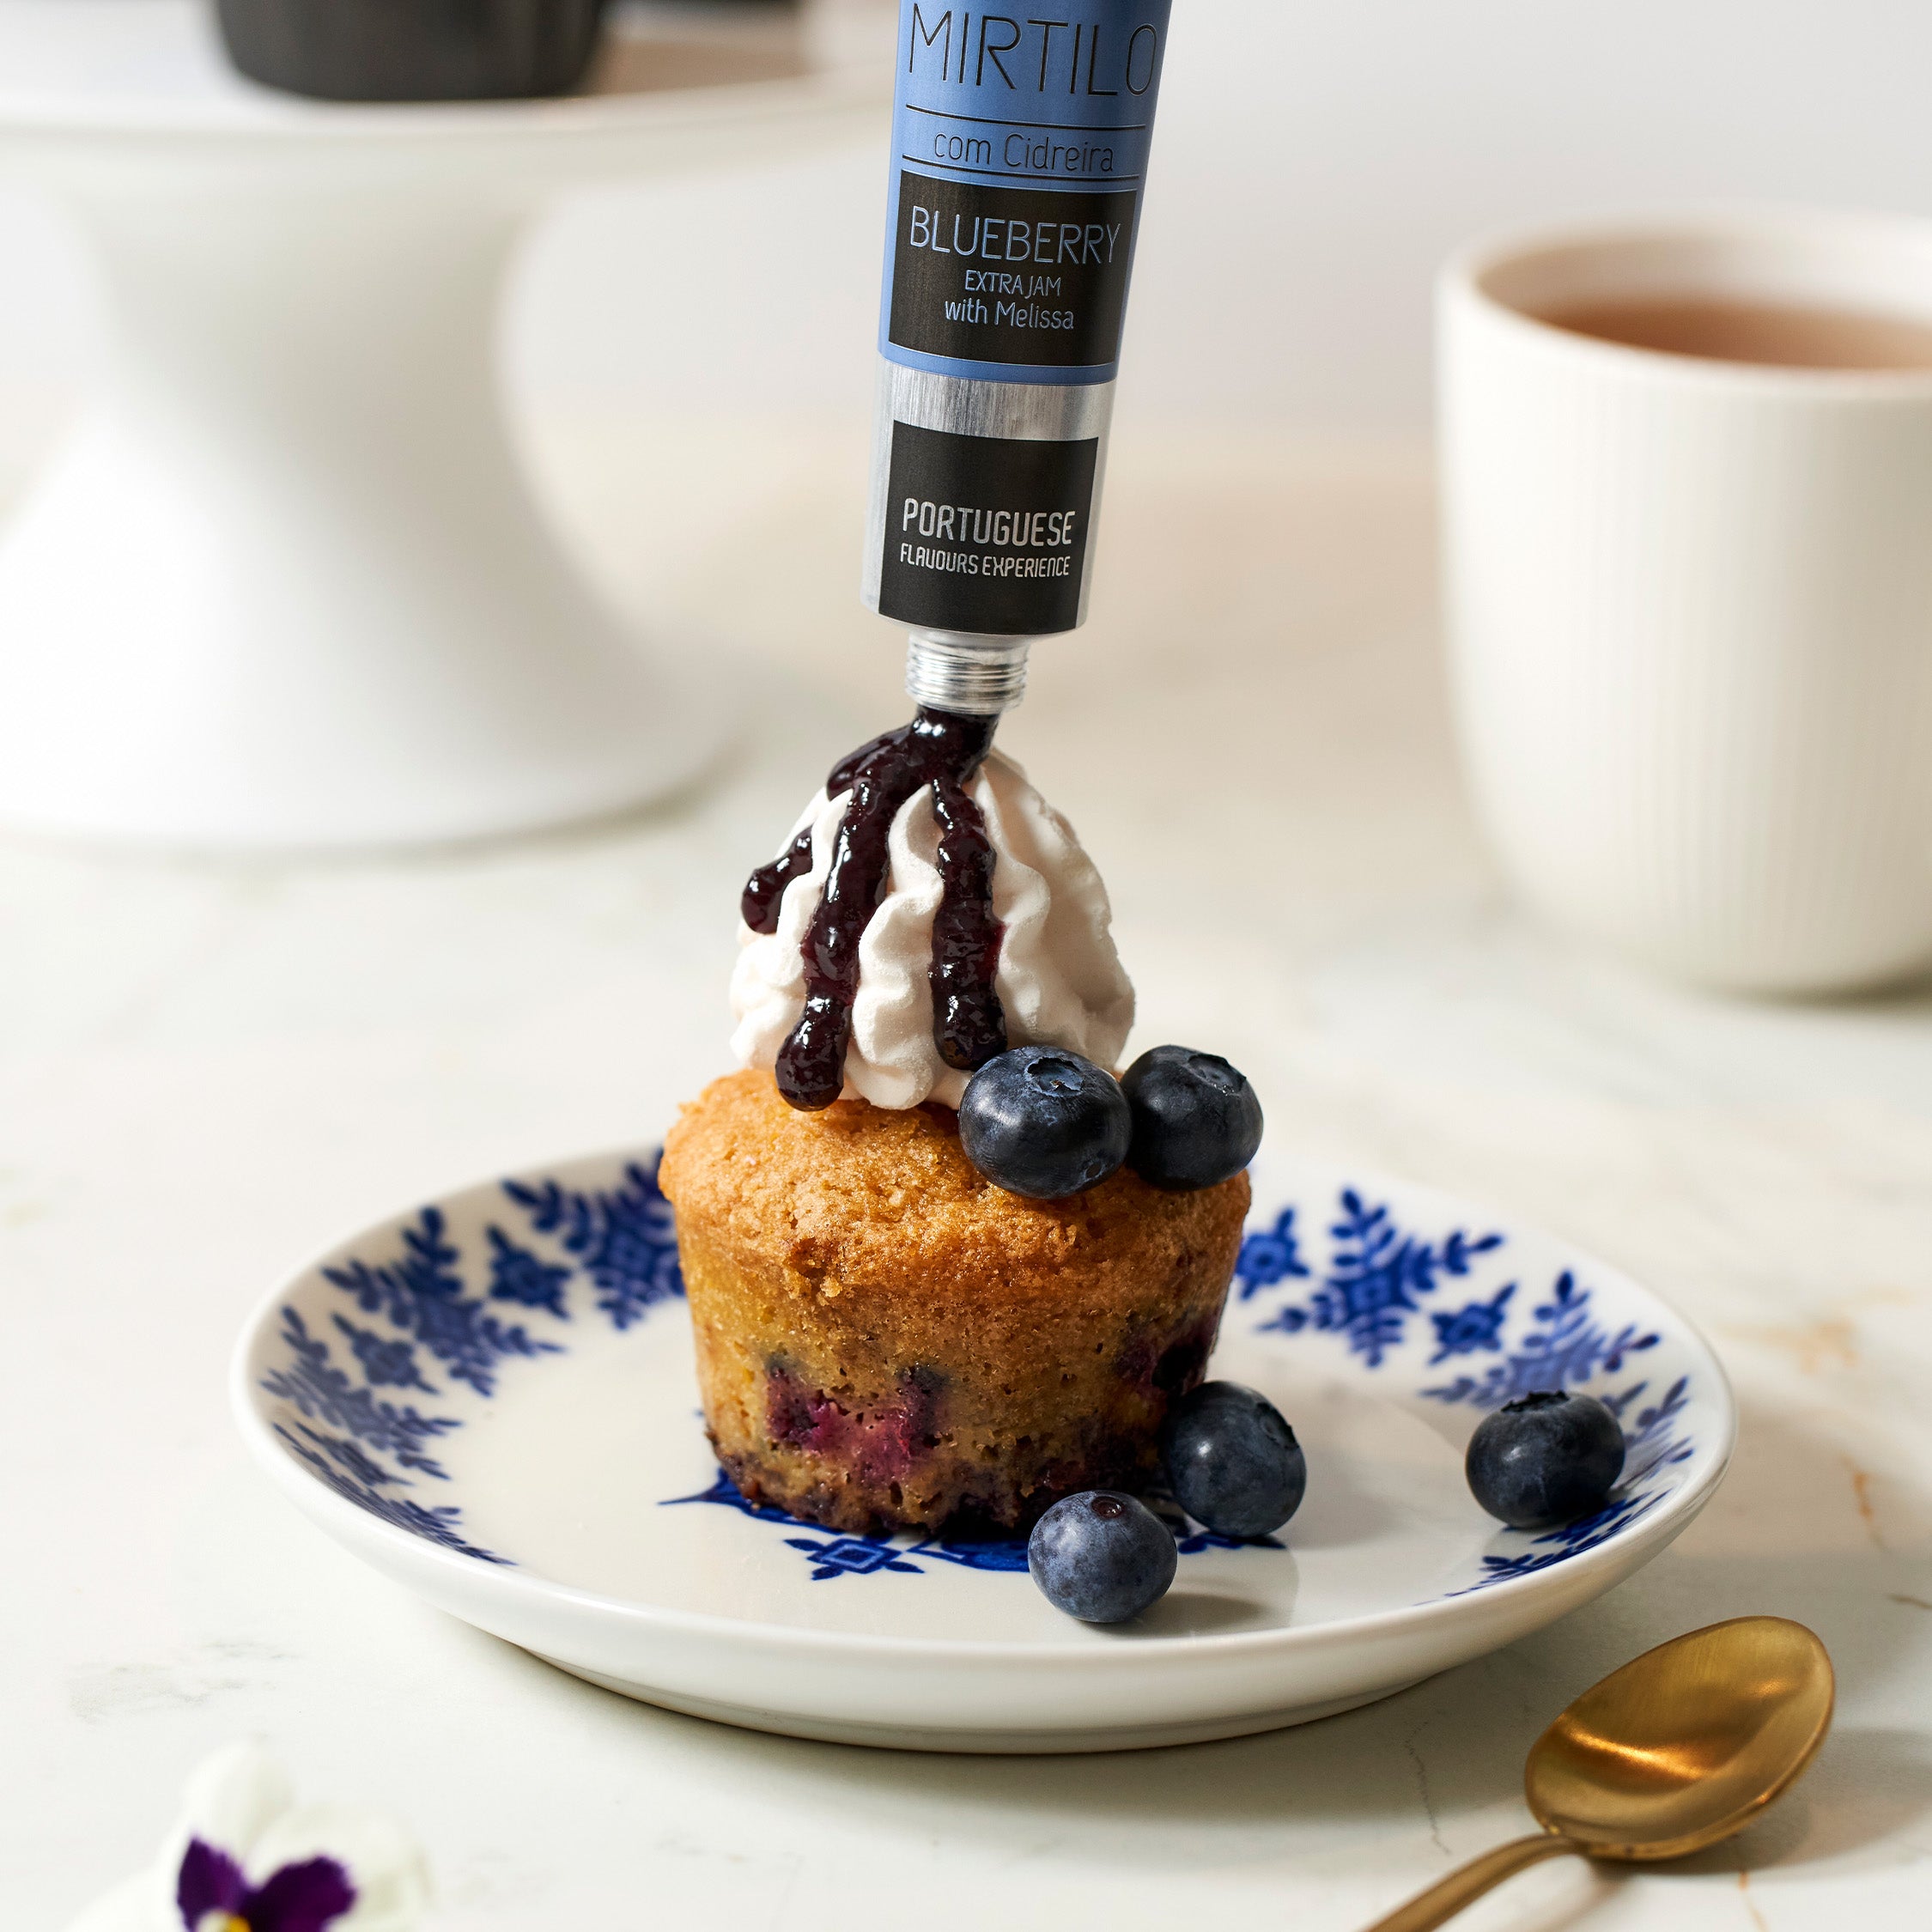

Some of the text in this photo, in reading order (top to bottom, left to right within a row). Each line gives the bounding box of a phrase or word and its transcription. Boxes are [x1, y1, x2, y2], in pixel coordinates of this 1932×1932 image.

[909, 3, 1157, 96] MIRTILO
[934, 132, 1114, 172] com Cidreira
[909, 205, 1121, 264] BLUEBERRY
[964, 269, 1061, 299] EXTRA JAM
[945, 298, 1074, 330] with Melissa
[902, 497, 1076, 547] PORTUGUESE
[982, 555, 1071, 578] EXPERIENCE
